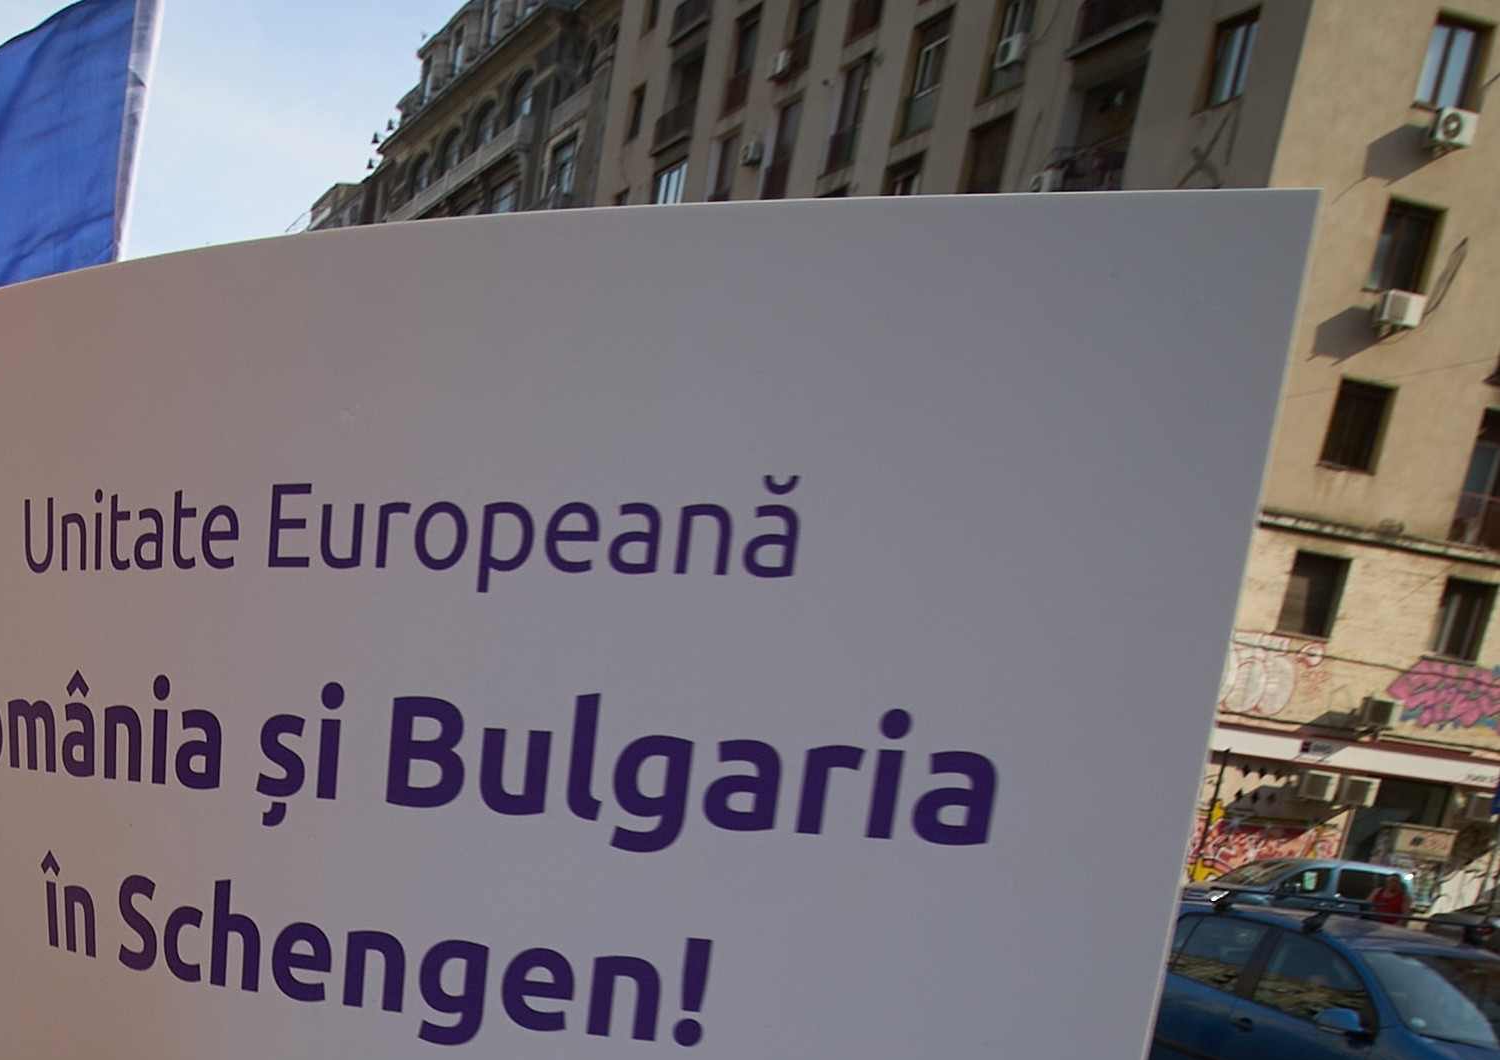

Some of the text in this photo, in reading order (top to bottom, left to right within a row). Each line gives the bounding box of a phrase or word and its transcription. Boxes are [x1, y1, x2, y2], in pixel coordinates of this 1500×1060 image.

[22, 474, 801, 593] Unitate Europeană
[255, 681, 345, 827] și
[384, 692, 998, 853] Bulgaria
[40, 849, 714, 1048] în Schengen!
